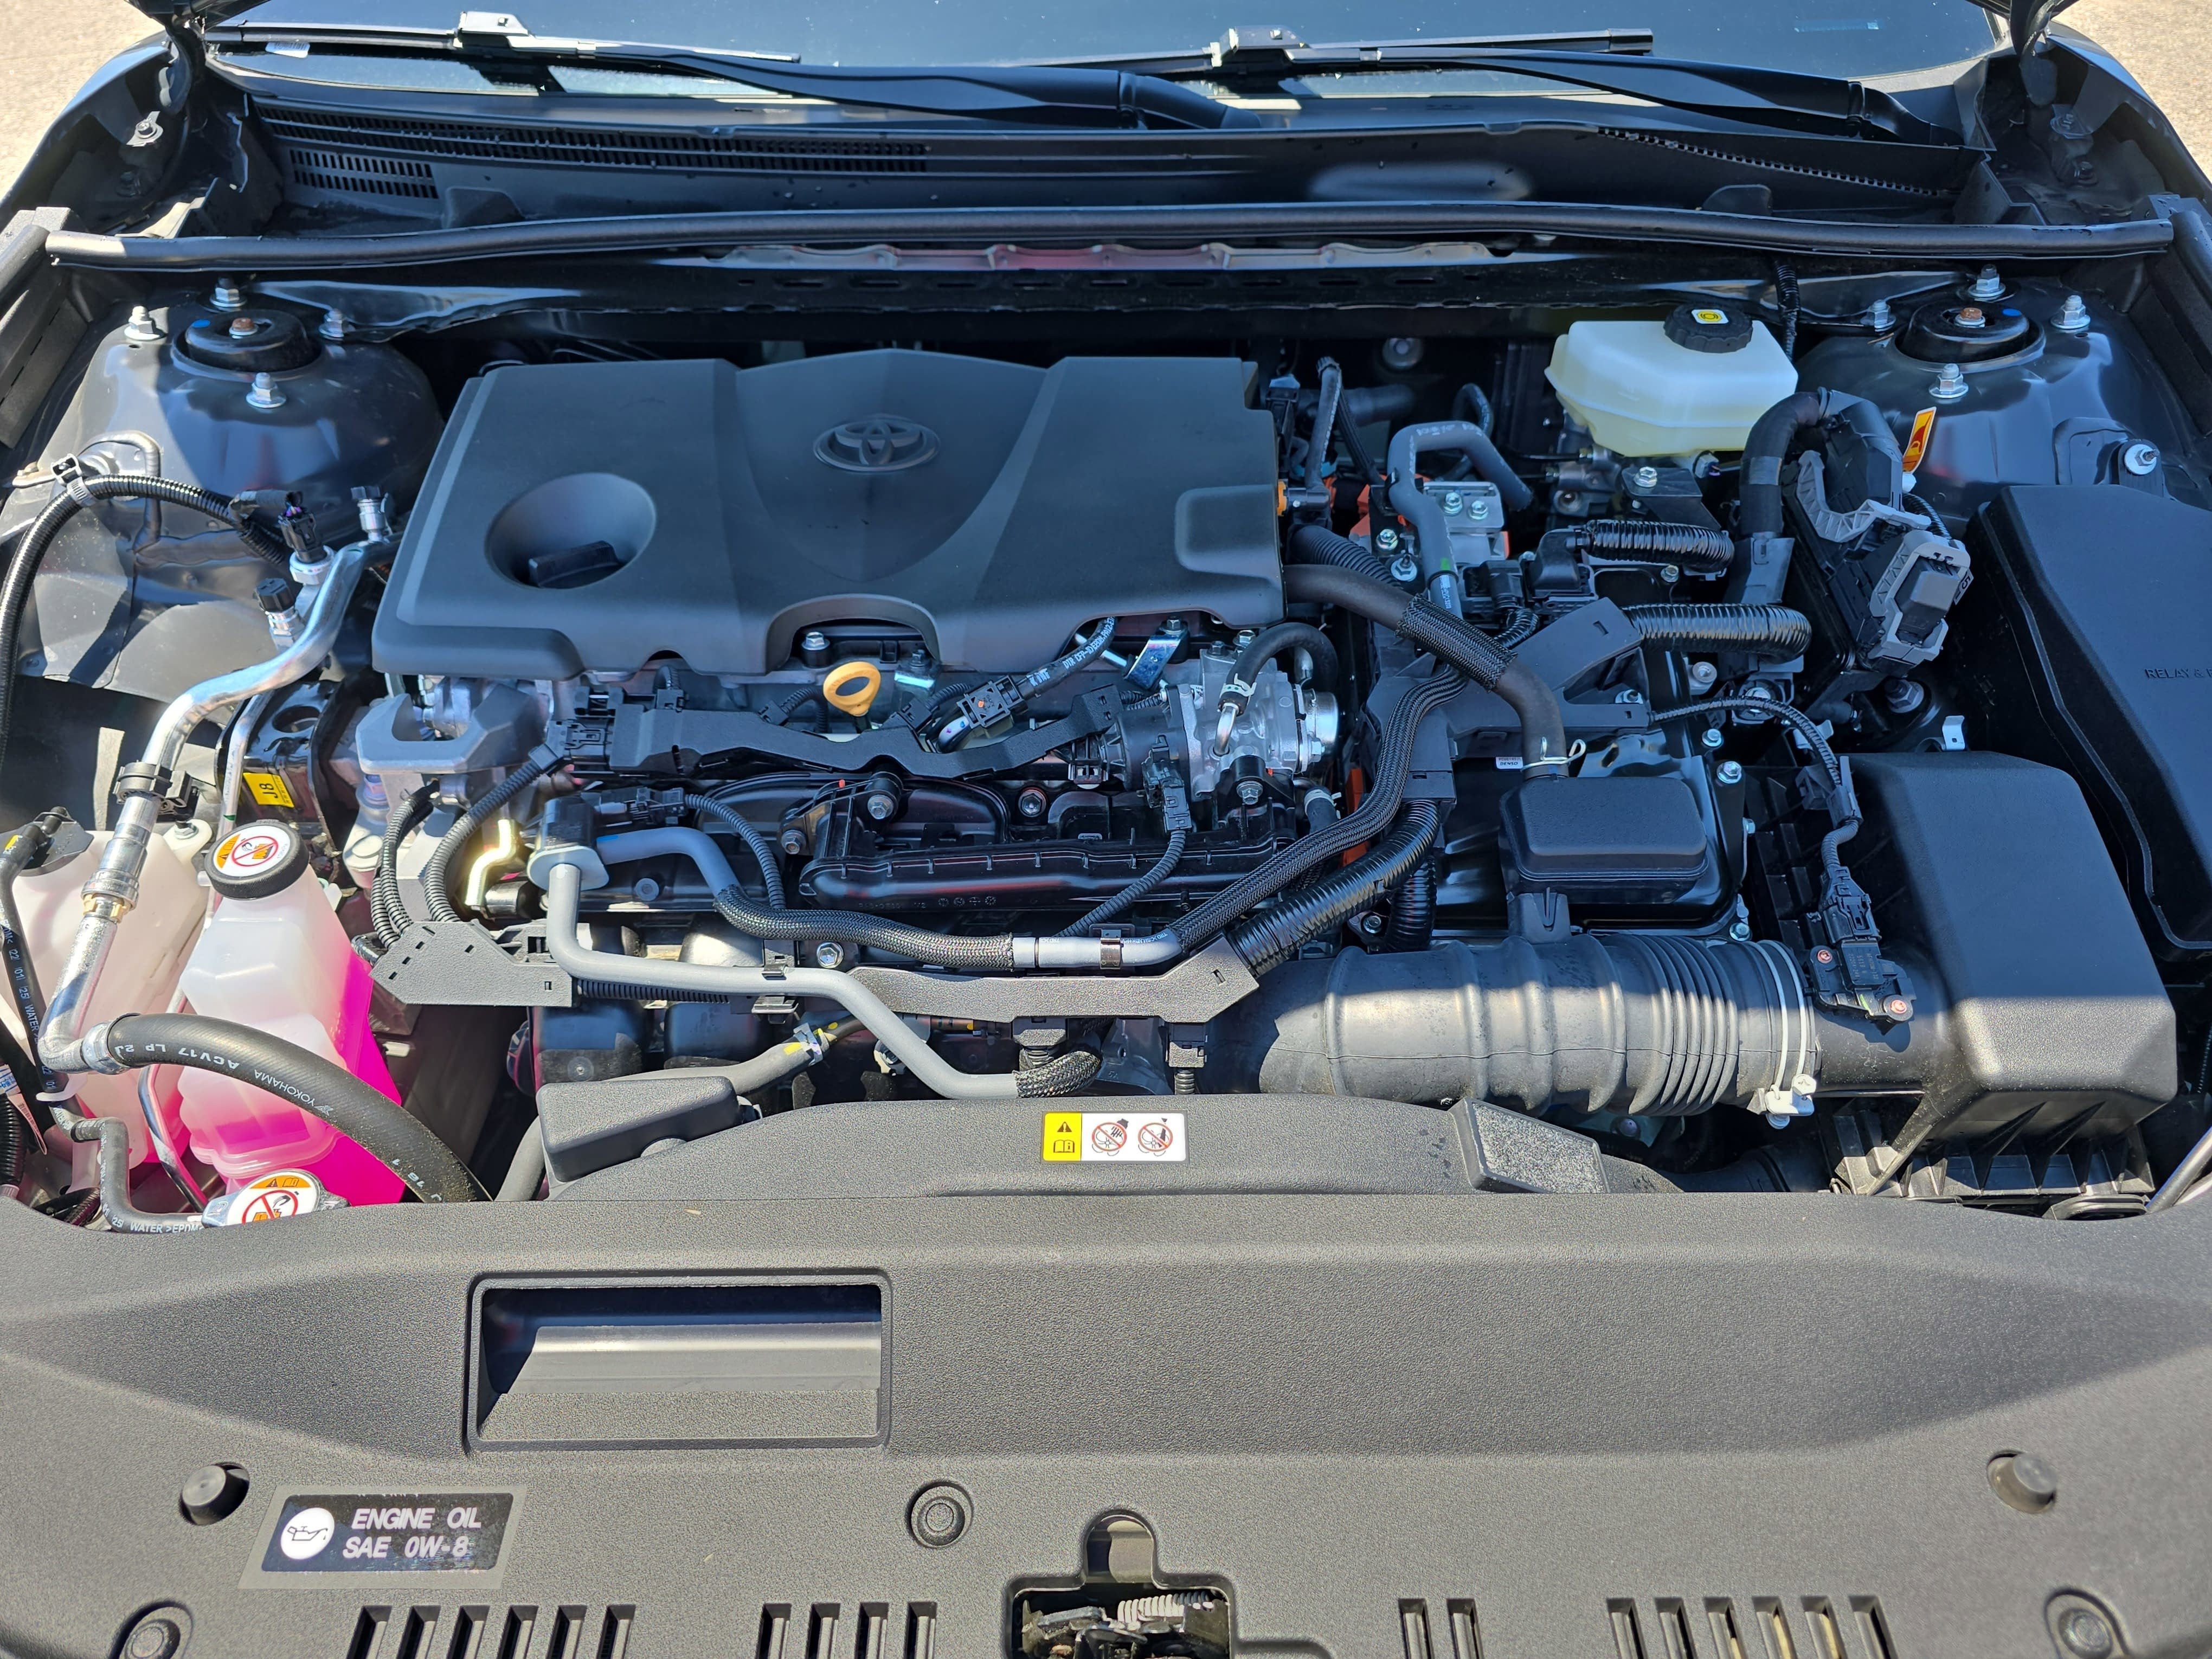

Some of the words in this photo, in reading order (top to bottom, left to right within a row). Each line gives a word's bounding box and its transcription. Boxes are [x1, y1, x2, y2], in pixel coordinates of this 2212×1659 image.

[2145, 668, 2190, 679] RELAY
[2194, 668, 2204, 678] &
[259, 783, 279, 799] J8
[24, 1004, 40, 1031] WATER
[114, 1044, 134, 1060] 2J
[145, 1044, 166, 1052] LP
[178, 1047, 240, 1070] ACV17
[254, 1069, 316, 1107] YOKOHAMA
[130, 1222, 163, 1233] WATER
[351, 1507, 436, 1530] ENGINE
[447, 1507, 482, 1529] OIL
[342, 1536, 392, 1559] SAE
[404, 1535, 470, 1558] 0W-8
